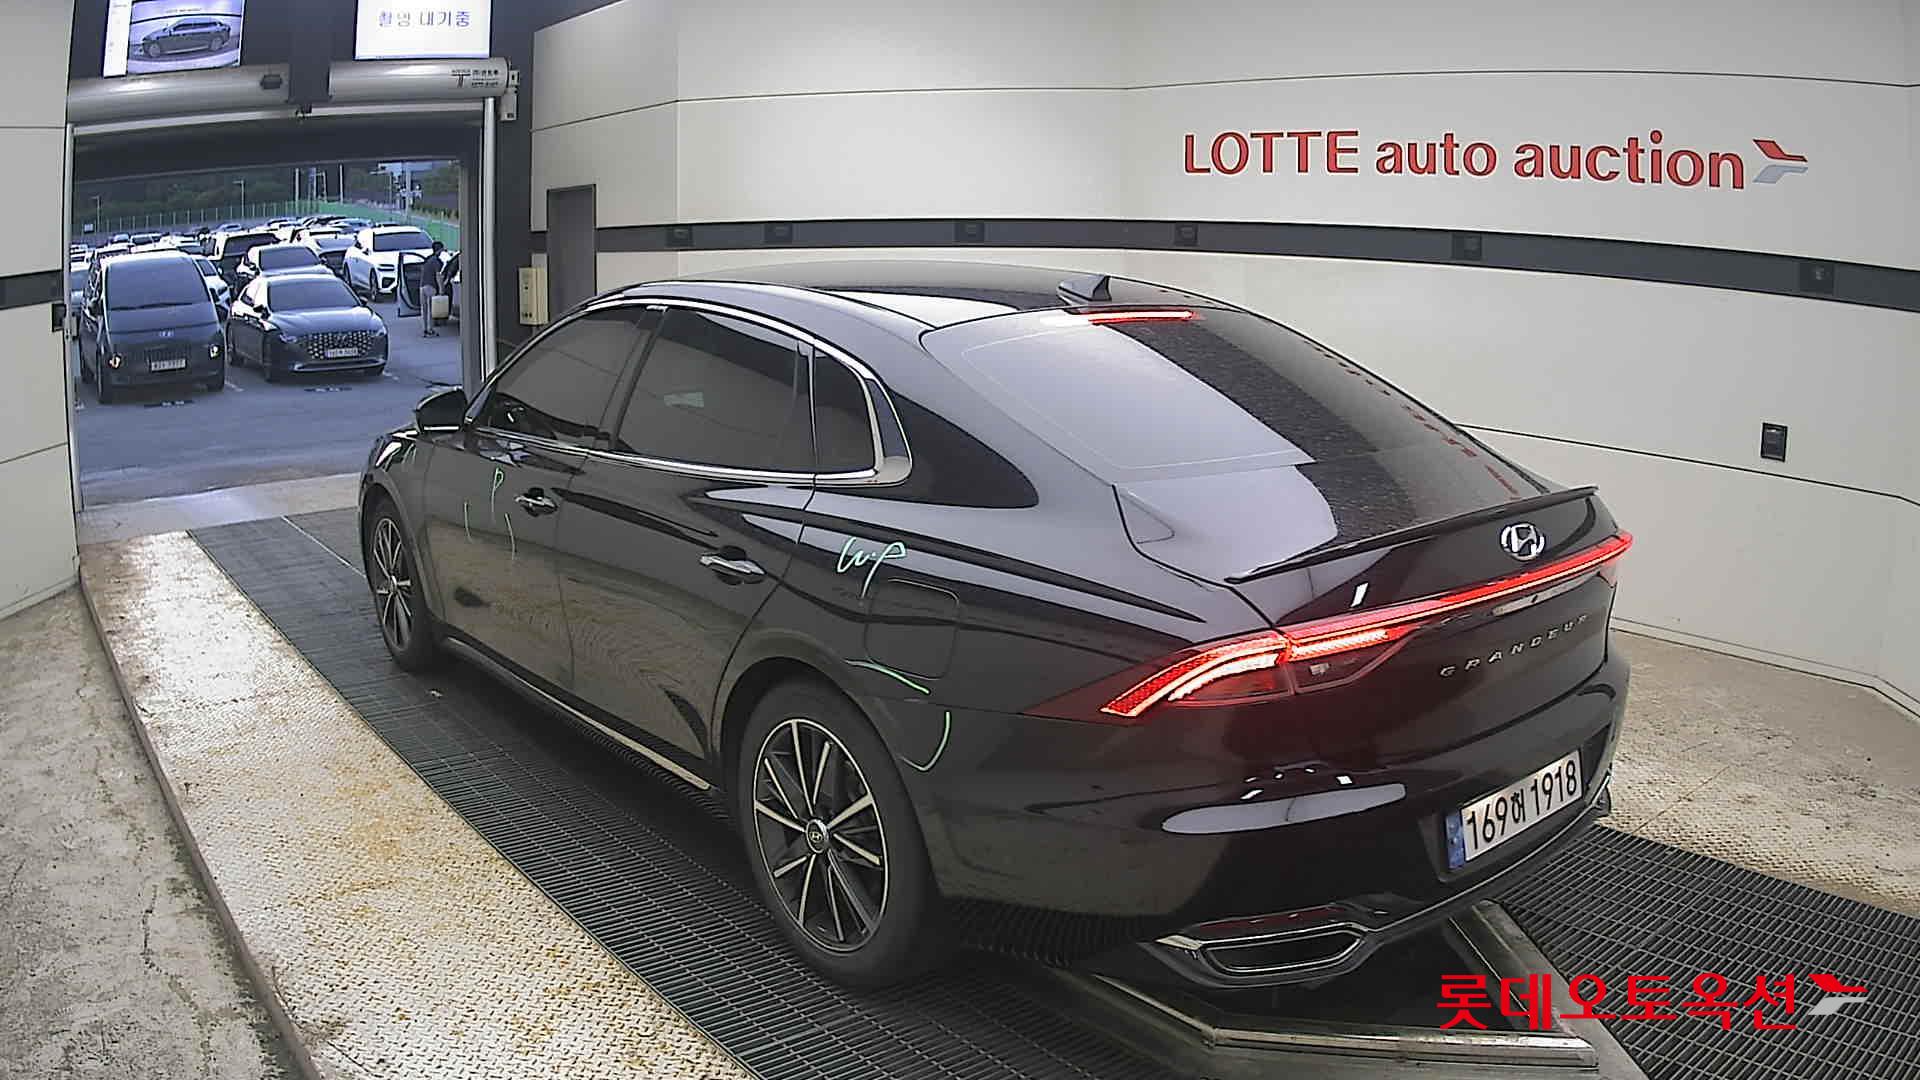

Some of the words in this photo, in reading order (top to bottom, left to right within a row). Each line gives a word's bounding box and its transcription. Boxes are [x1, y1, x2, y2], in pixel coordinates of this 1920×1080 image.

[419, 10, 471, 28] 대기중
[1184, 130, 1359, 175] LOTTE
[1376, 132, 1497, 177] auto
[1513, 130, 1745, 190] auction
[1440, 613, 1588, 677] GRANDEUR
[1466, 788, 1526, 850] 169허
[1531, 759, 1578, 816] 1918
